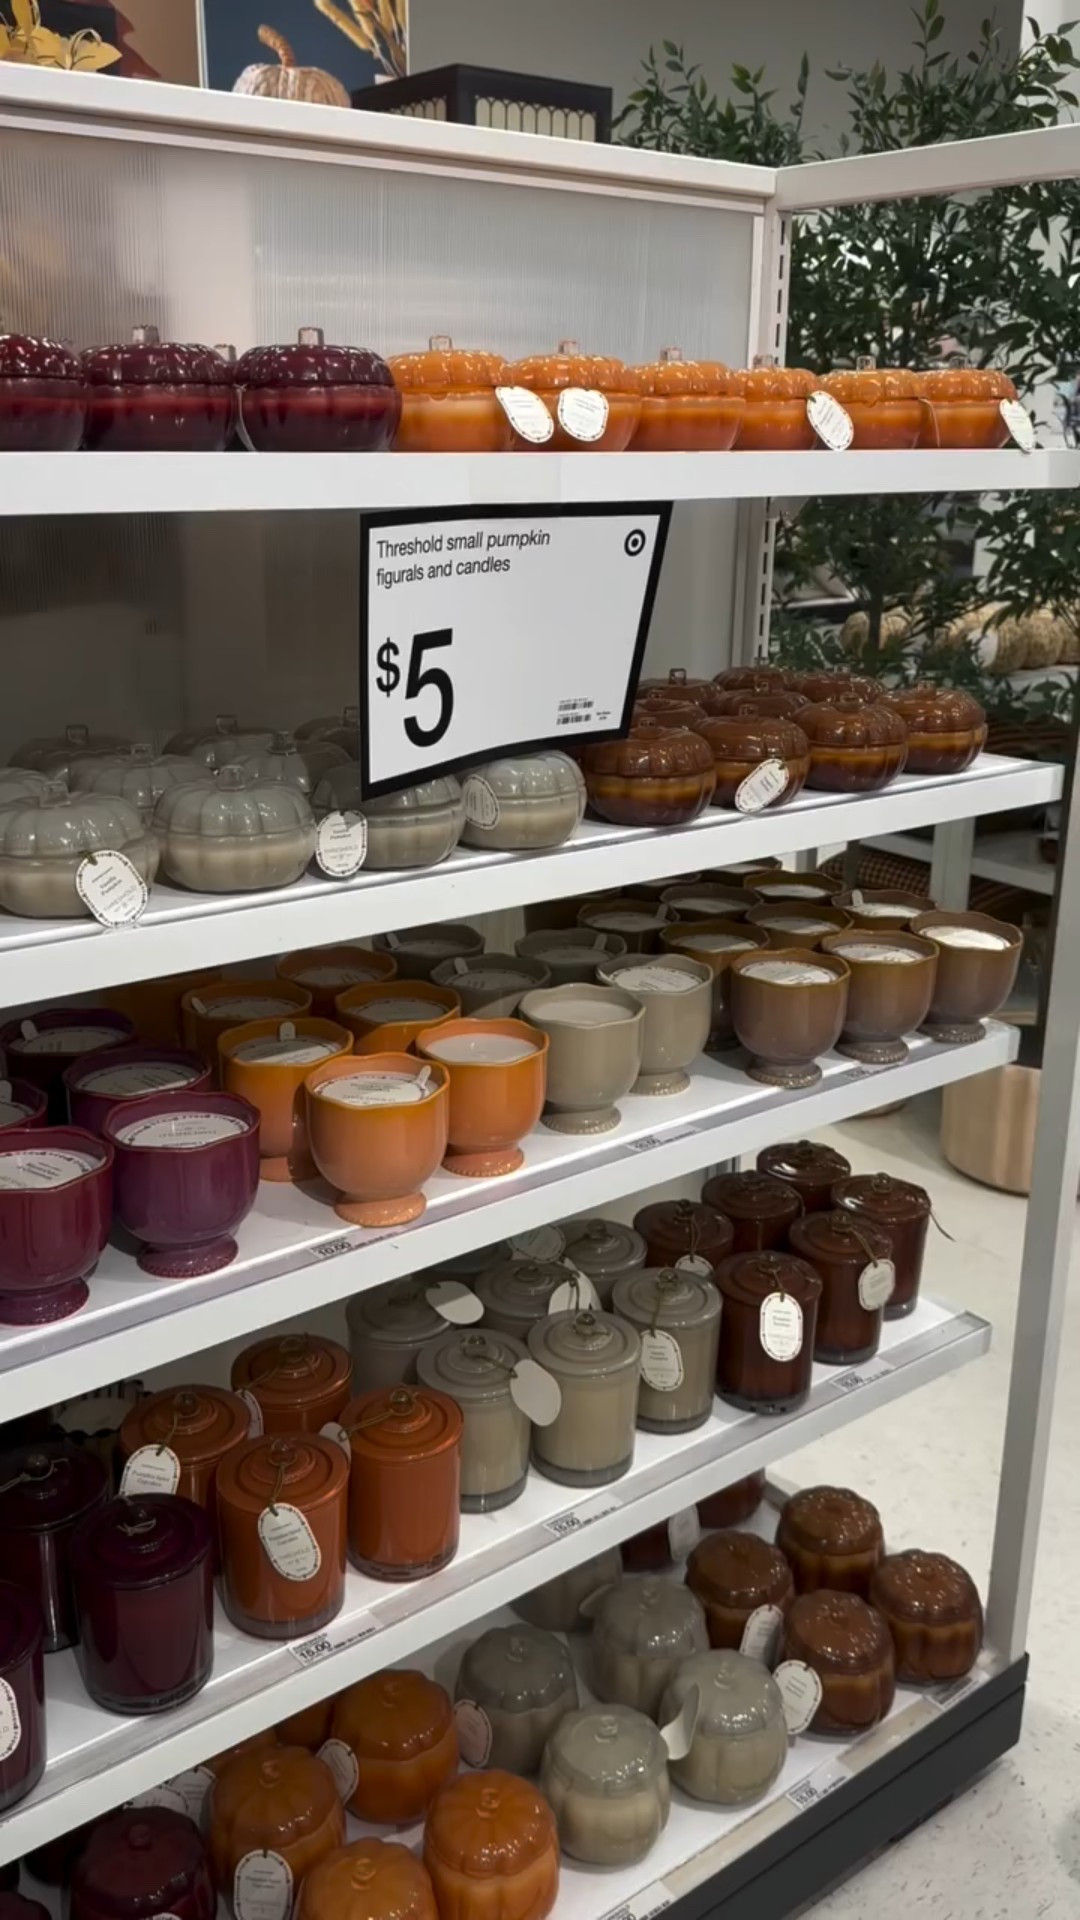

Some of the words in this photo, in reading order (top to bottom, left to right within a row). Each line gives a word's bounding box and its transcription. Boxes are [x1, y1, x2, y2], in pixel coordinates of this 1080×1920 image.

[377, 535, 443, 559] Threshold
[446, 531, 483, 551] small
[487, 529, 551, 551] pumpkin
[376, 564, 424, 589] figurals
[427, 560, 452, 578] and
[456, 556, 511, 575] candles
[376, 627, 454, 748] $5
[299, 1640, 332, 1659] 15.00
